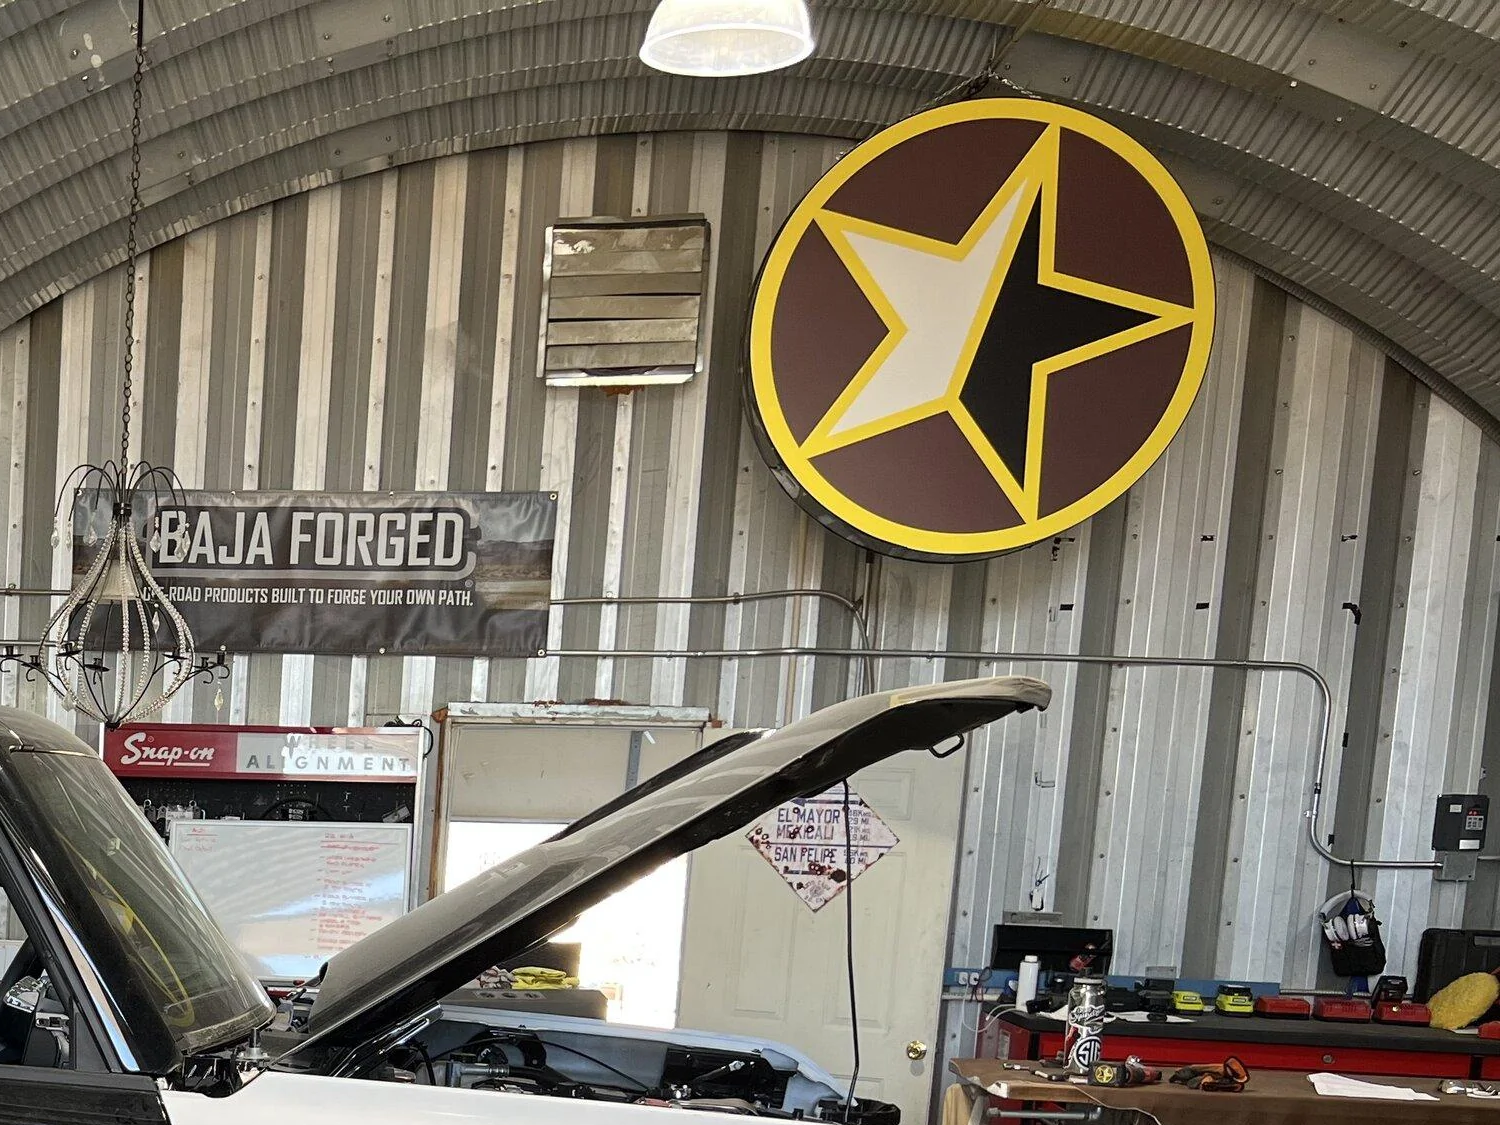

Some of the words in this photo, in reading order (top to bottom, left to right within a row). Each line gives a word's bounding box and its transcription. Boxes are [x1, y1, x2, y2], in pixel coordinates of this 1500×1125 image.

[158, 510, 274, 565] BAJA
[289, 511, 464, 566] FORGED
[204, 587, 268, 604] PRODUCTS
[271, 588, 306, 604] BUILT
[308, 588, 324, 604] TO
[327, 589, 367, 605] FORGE
[370, 589, 403, 605] YOUR
[406, 590, 435, 605] OWN
[438, 590, 474, 606] PATH.
[120, 732, 215, 767] Snap-on
[777, 807, 792, 823] EL
[796, 808, 841, 824] MAYOR
[776, 824, 835, 840] MEXICALI
[774, 846, 797, 862] SAN
